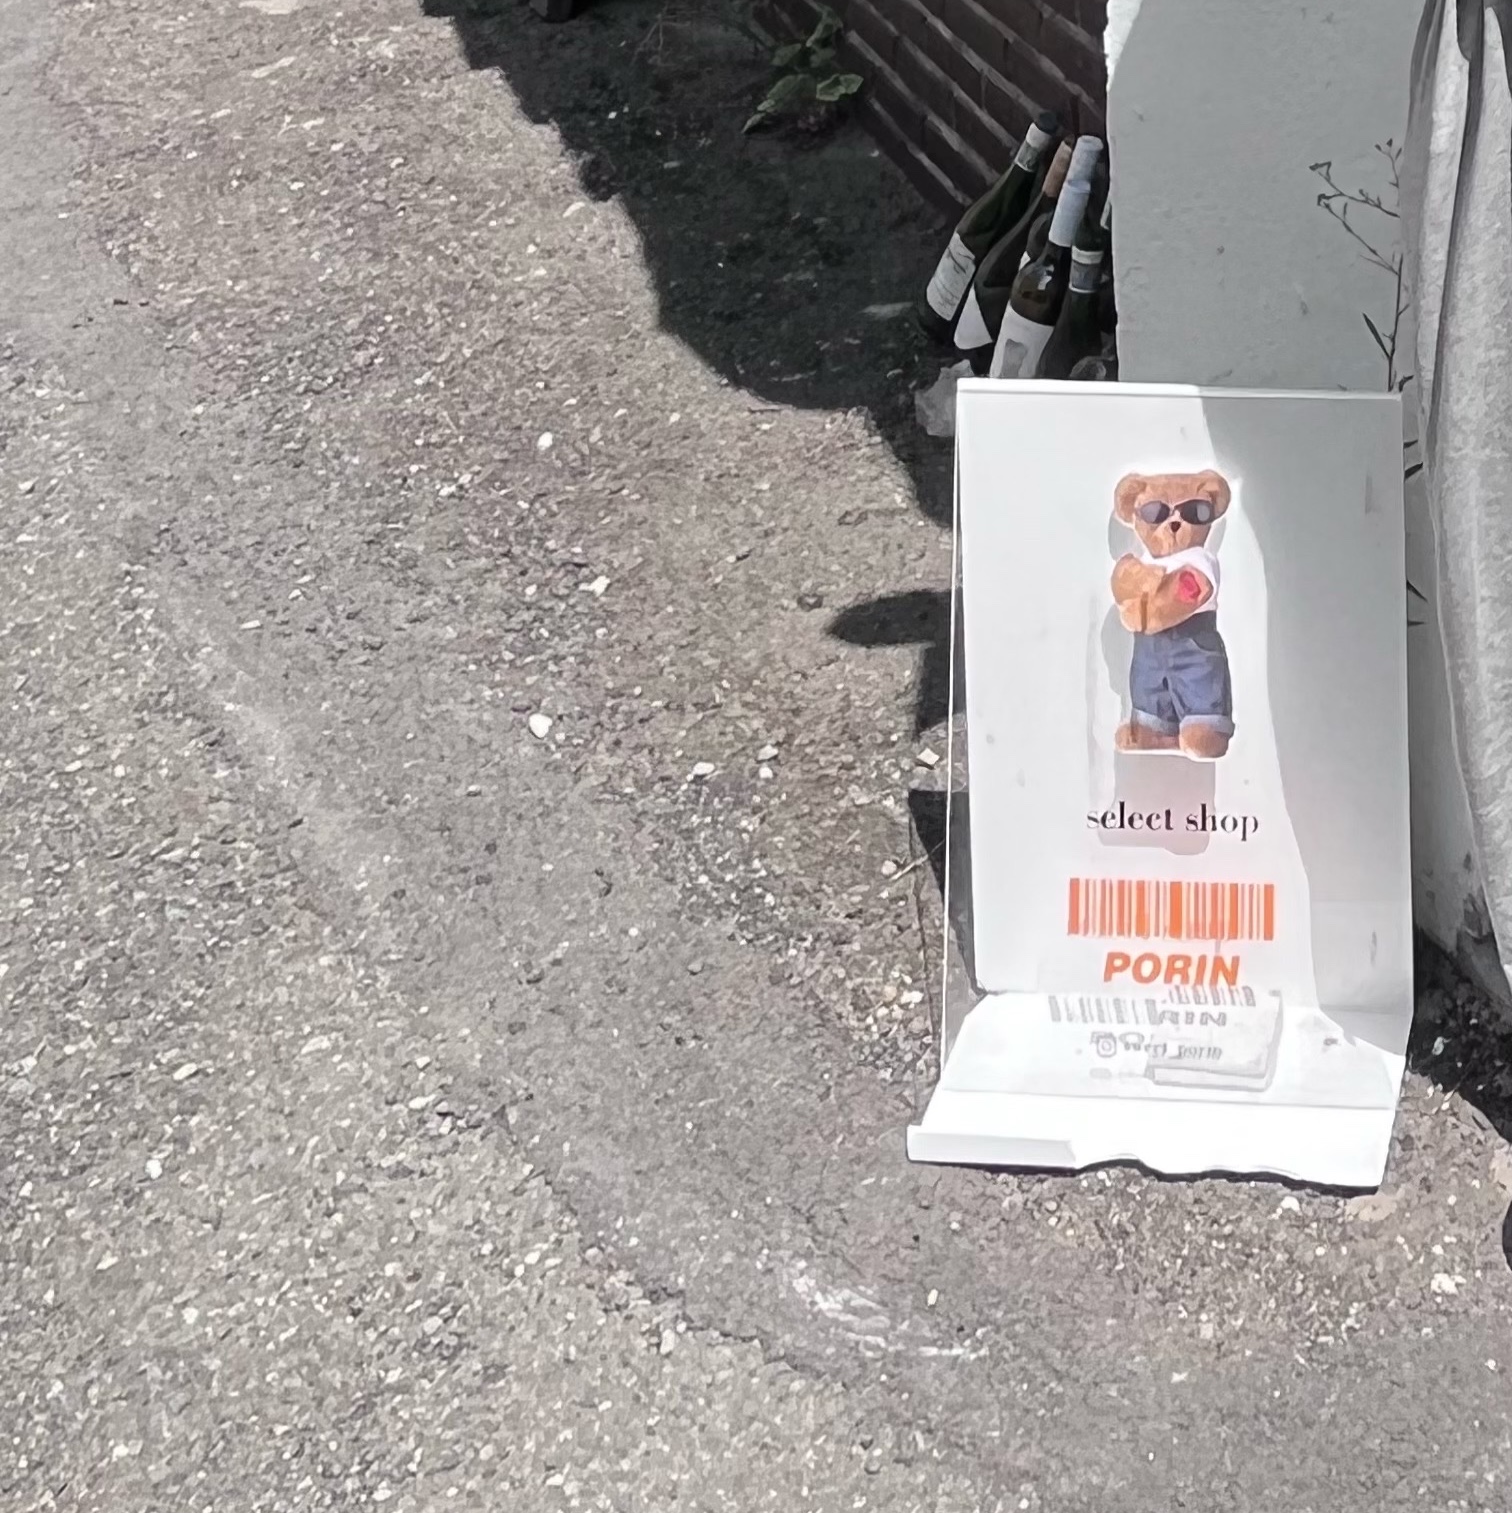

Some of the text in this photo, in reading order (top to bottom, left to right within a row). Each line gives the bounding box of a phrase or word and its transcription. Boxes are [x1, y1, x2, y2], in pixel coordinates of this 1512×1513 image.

[1086, 800, 1259, 842] select shop
[1103, 951, 1241, 986] PORIN
